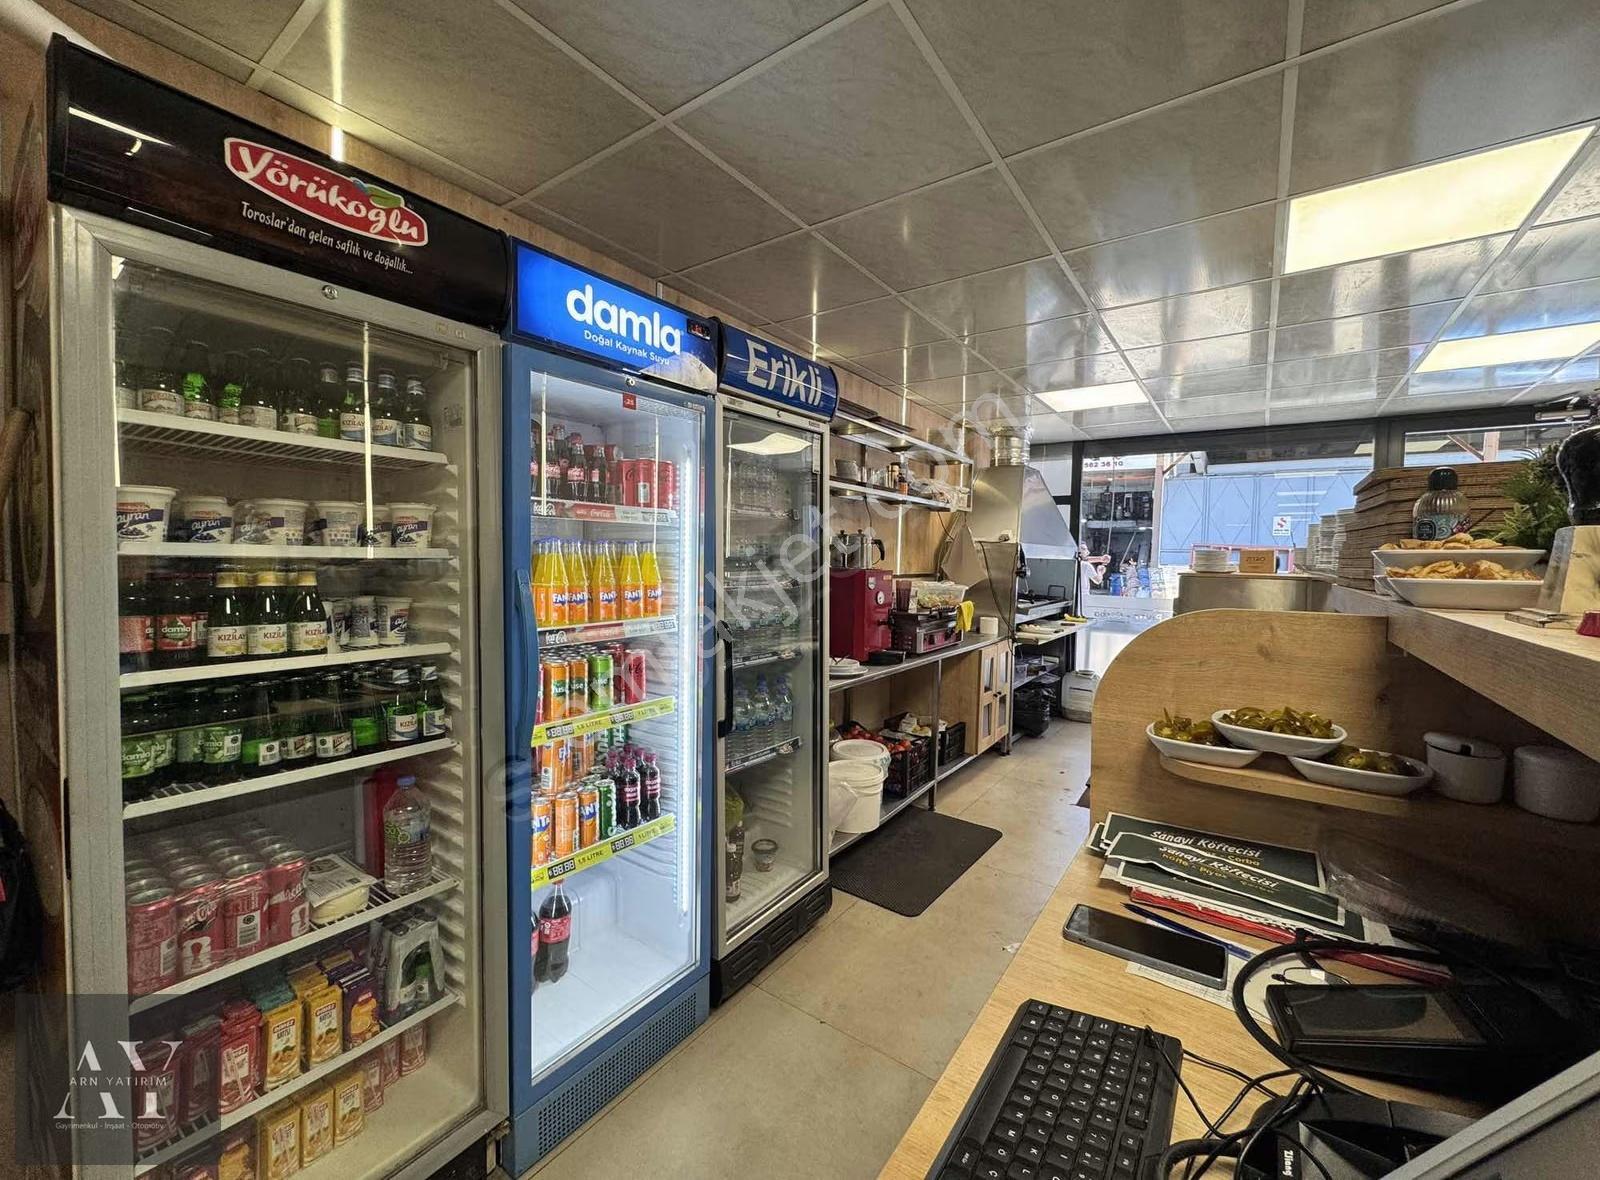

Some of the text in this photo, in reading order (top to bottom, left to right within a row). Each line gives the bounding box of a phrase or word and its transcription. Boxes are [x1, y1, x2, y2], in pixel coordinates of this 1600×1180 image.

[241, 201, 306, 238] Toroslar'dan
[308, 230, 334, 247] gelen
[336, 240, 360, 256] saflık
[362, 251, 373, 261] ve
[566, 284, 681, 355] damla
[584, 330, 670, 366] Doğal Kaynak Suyu
[746, 339, 822, 406] Erikli
[162, 623, 191, 633] damla
[1150, 831, 1262, 858] Sanayi Köftecisi
[1159, 846, 1205, 863] Sanayi
[1210, 861, 1279, 888] Köftecisi
